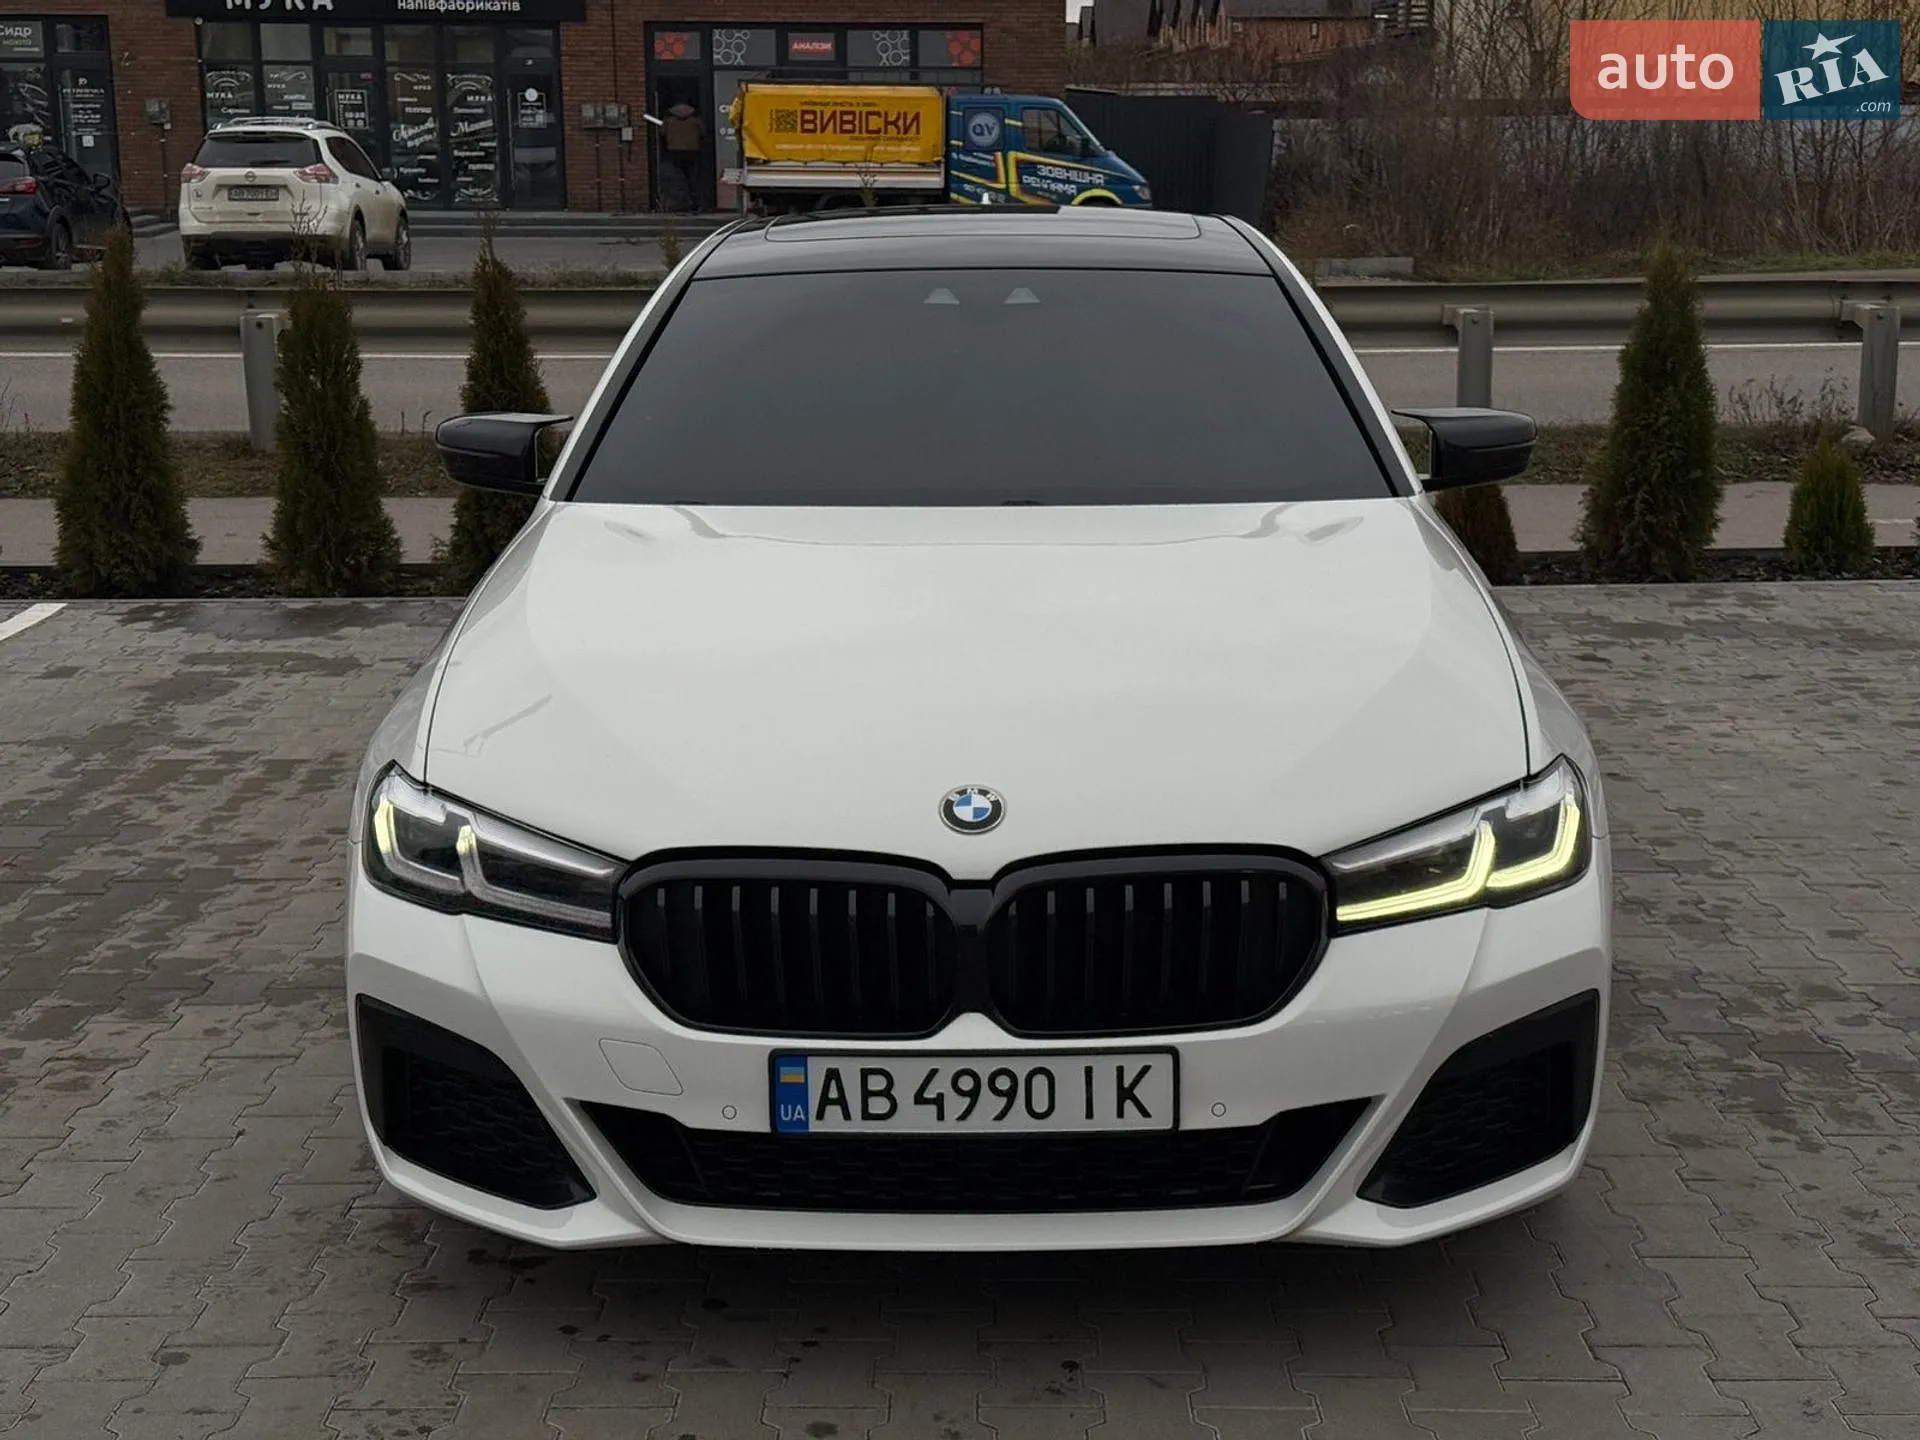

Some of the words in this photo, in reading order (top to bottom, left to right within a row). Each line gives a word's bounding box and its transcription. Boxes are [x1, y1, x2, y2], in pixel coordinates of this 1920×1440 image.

[800, 110, 920, 135] ВИВІСКИ
[815, 1067, 898, 1121] AB
[913, 1066, 1056, 1121] 4990
[780, 1103, 805, 1121] UA
